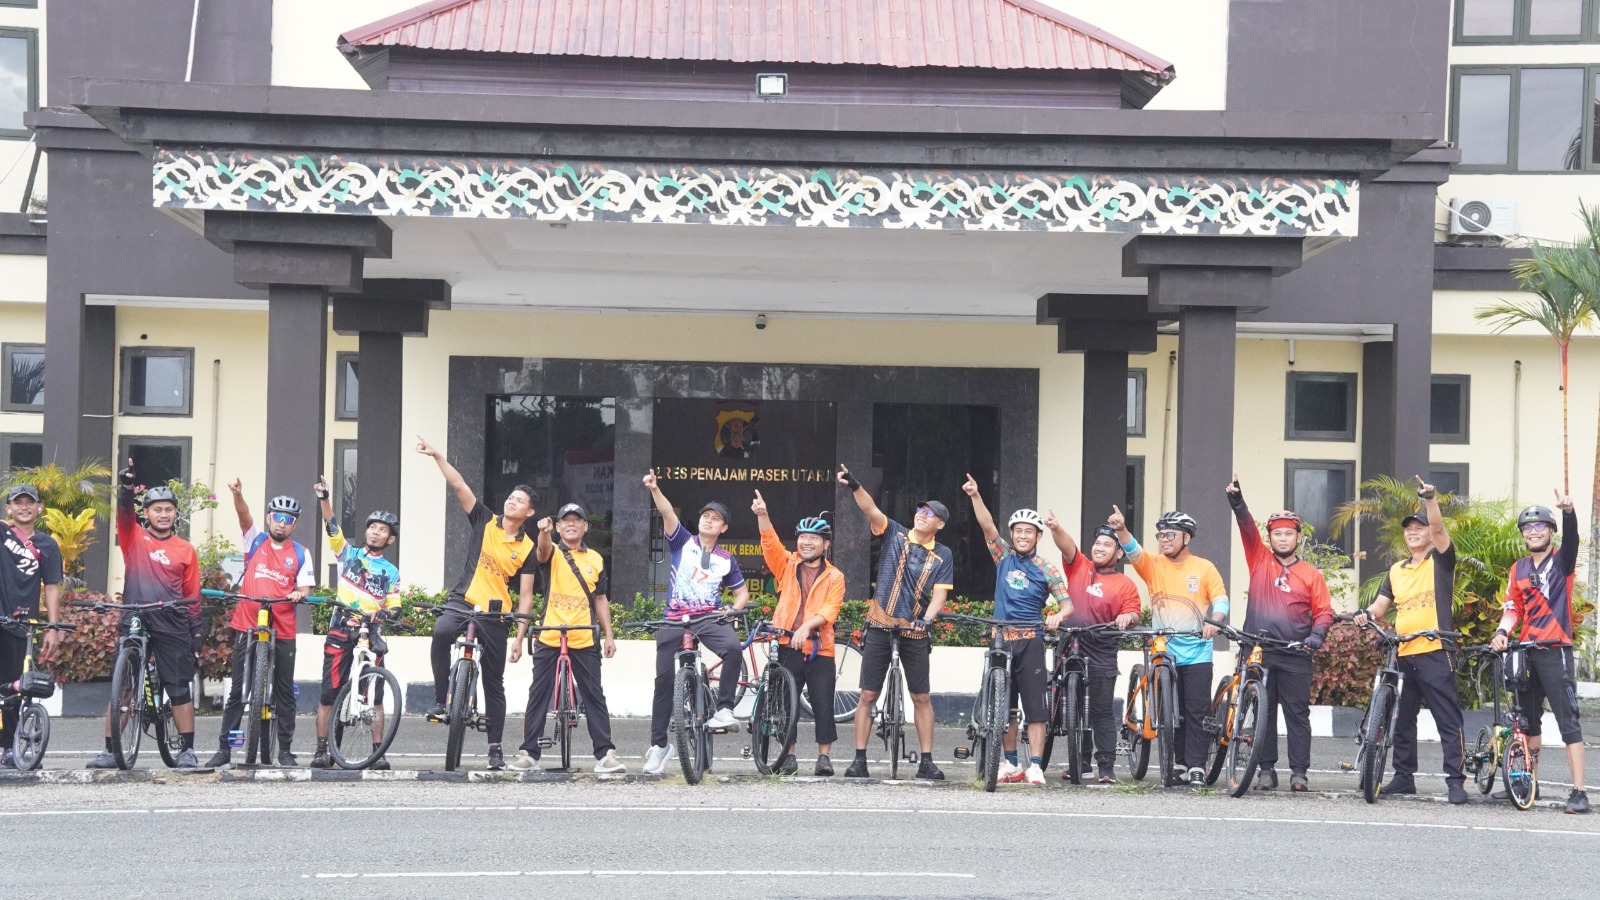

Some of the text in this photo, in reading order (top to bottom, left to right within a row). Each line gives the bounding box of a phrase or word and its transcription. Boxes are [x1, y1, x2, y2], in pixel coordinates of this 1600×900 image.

[690, 467, 748, 481] PENAJAM
[750, 468, 789, 482] PASER
[792, 468, 834, 482] UTARA
[740, 543, 764, 556] BERM
[16, 558, 39, 576] 22
[690, 566, 710, 584] 17
